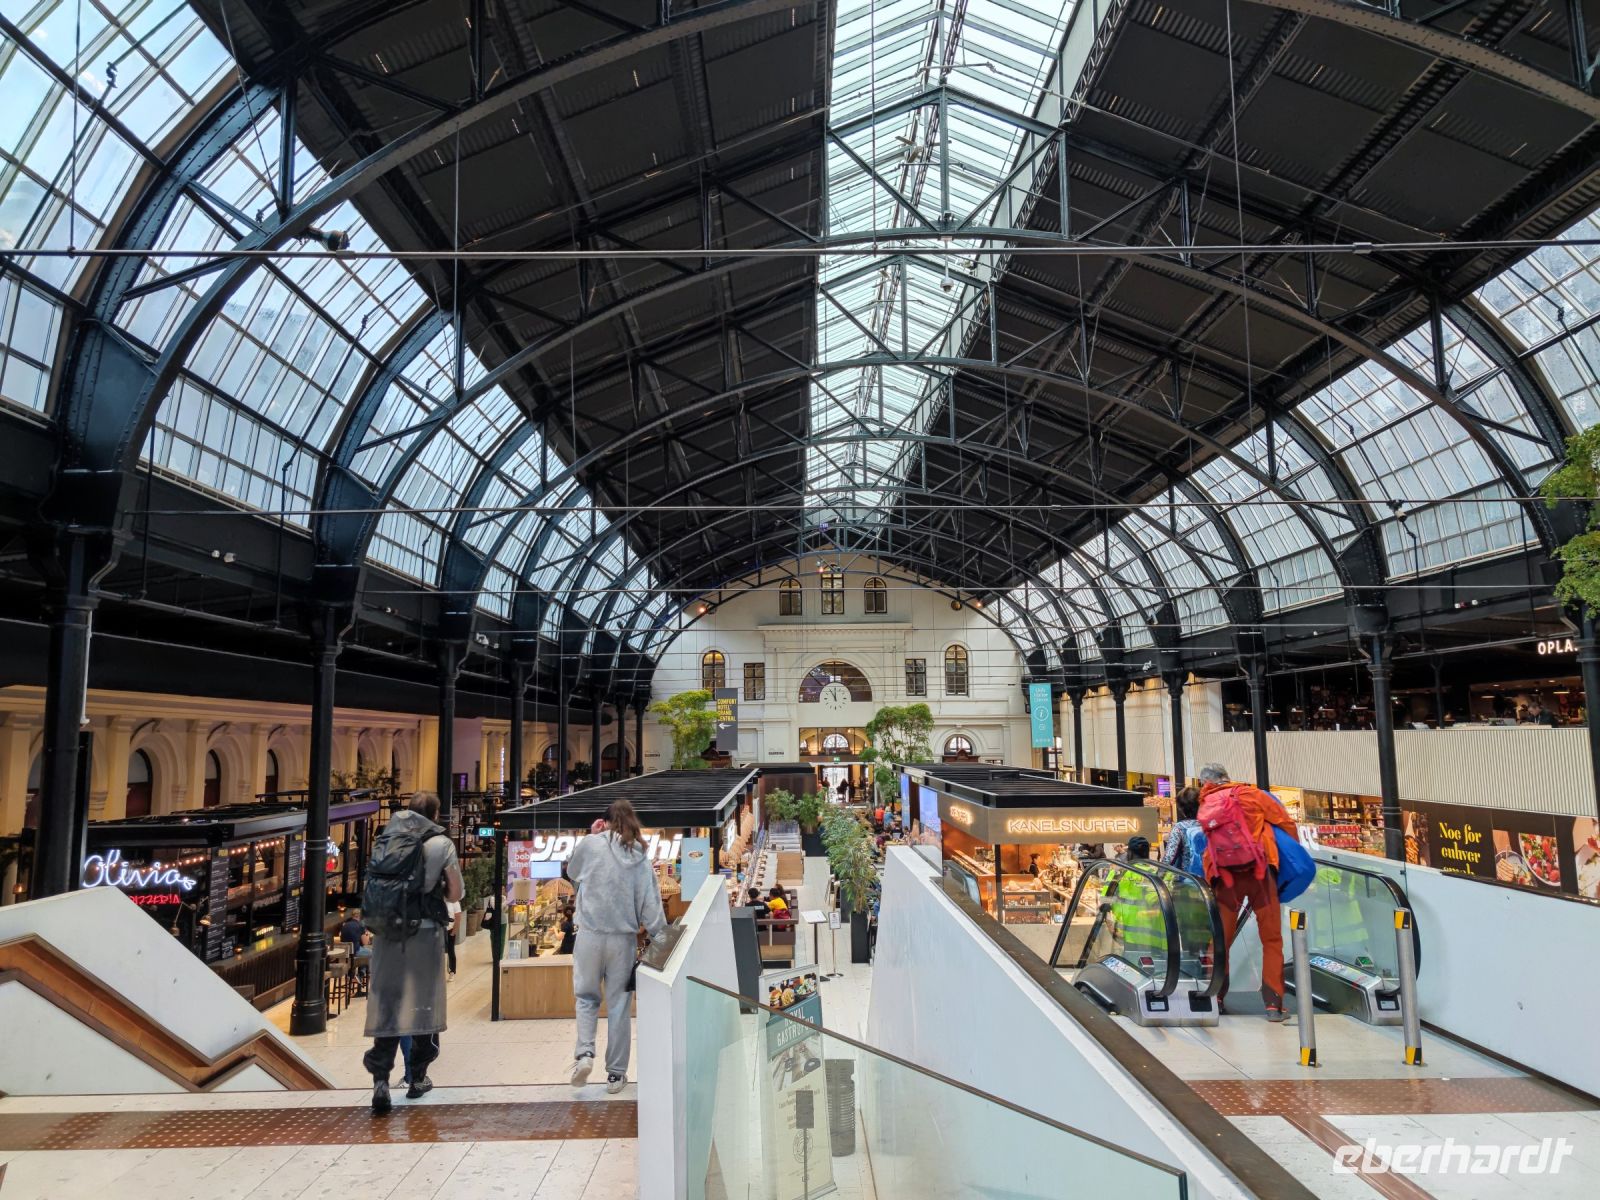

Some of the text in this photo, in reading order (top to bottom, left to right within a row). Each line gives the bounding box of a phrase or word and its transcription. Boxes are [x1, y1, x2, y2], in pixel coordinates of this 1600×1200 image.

[1007, 818, 1138, 833] KANELSNURREN
[1439, 821, 1482, 845] Noe for
[514, 852, 531, 860] bob
[1441, 841, 1481, 863] enhver
[83, 849, 197, 890] Olivia
